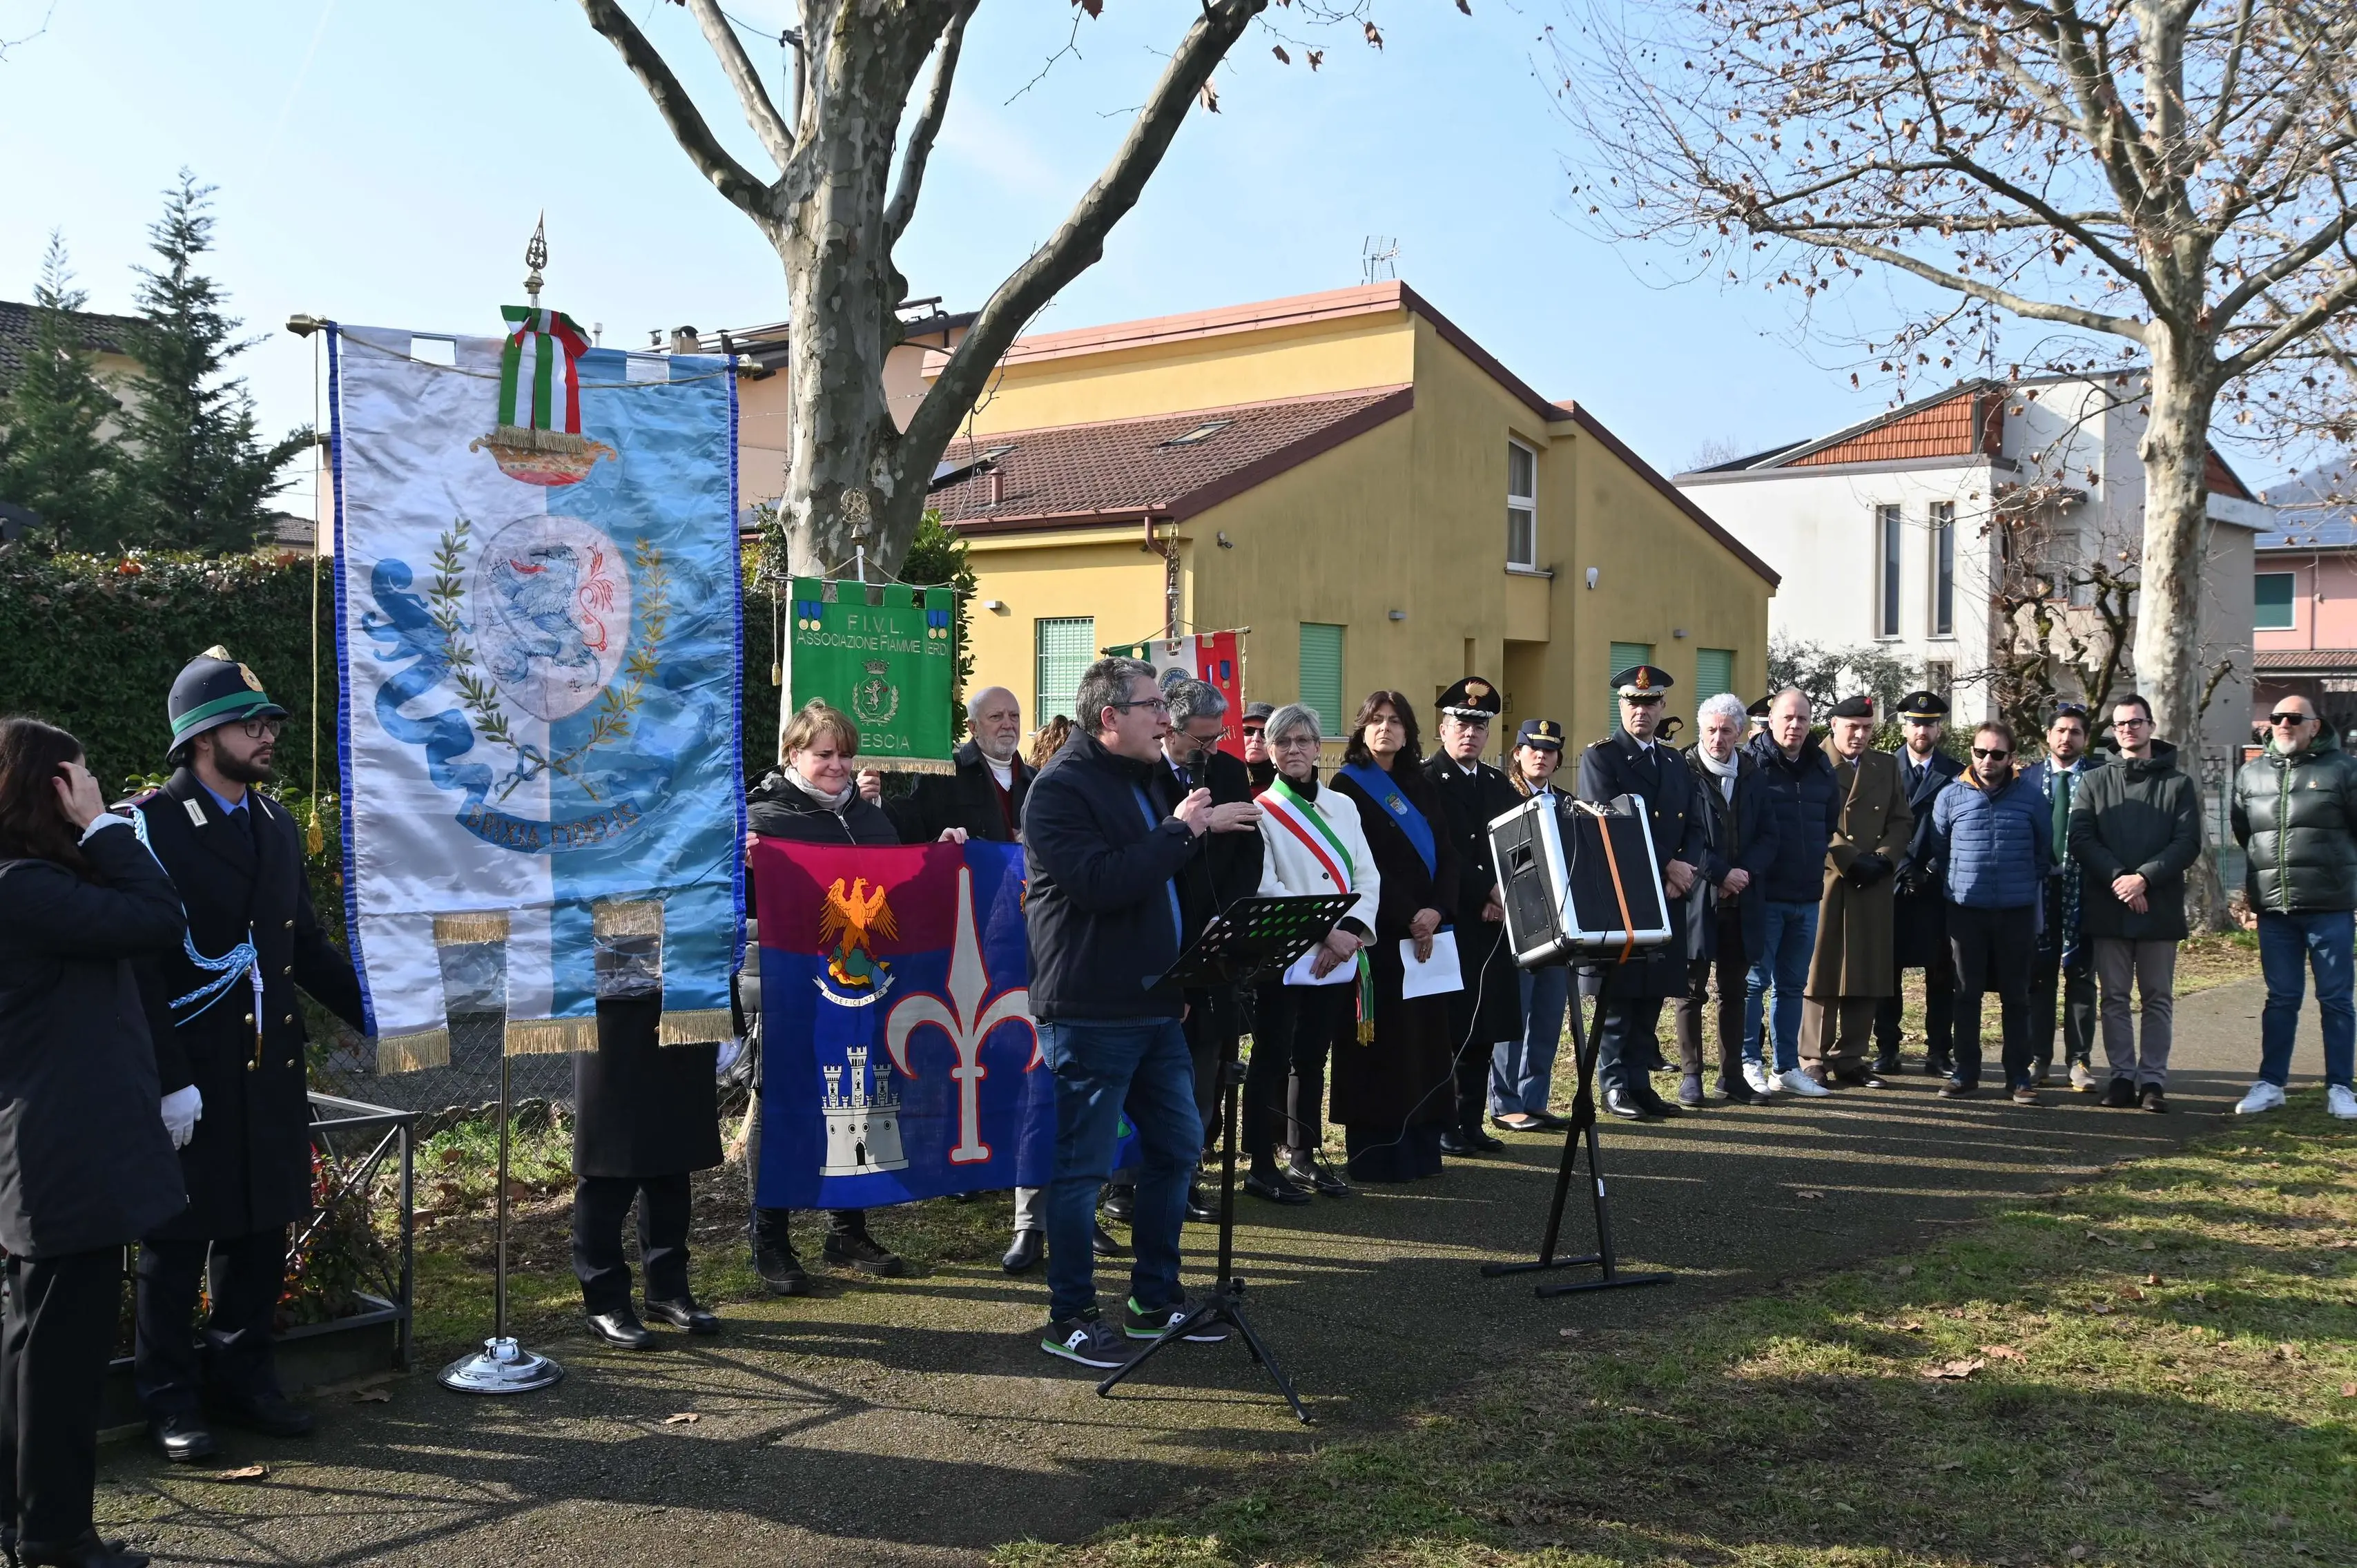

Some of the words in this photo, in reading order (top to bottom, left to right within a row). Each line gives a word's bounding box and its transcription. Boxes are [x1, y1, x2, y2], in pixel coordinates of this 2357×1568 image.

[796, 631, 878, 650] ASSOCIAZIONE
[880, 635, 921, 653] FIAMME
[924, 641, 949, 657] ERDI
[860, 733, 911, 751] ESCIA
[466, 802, 541, 849] BRIXIA
